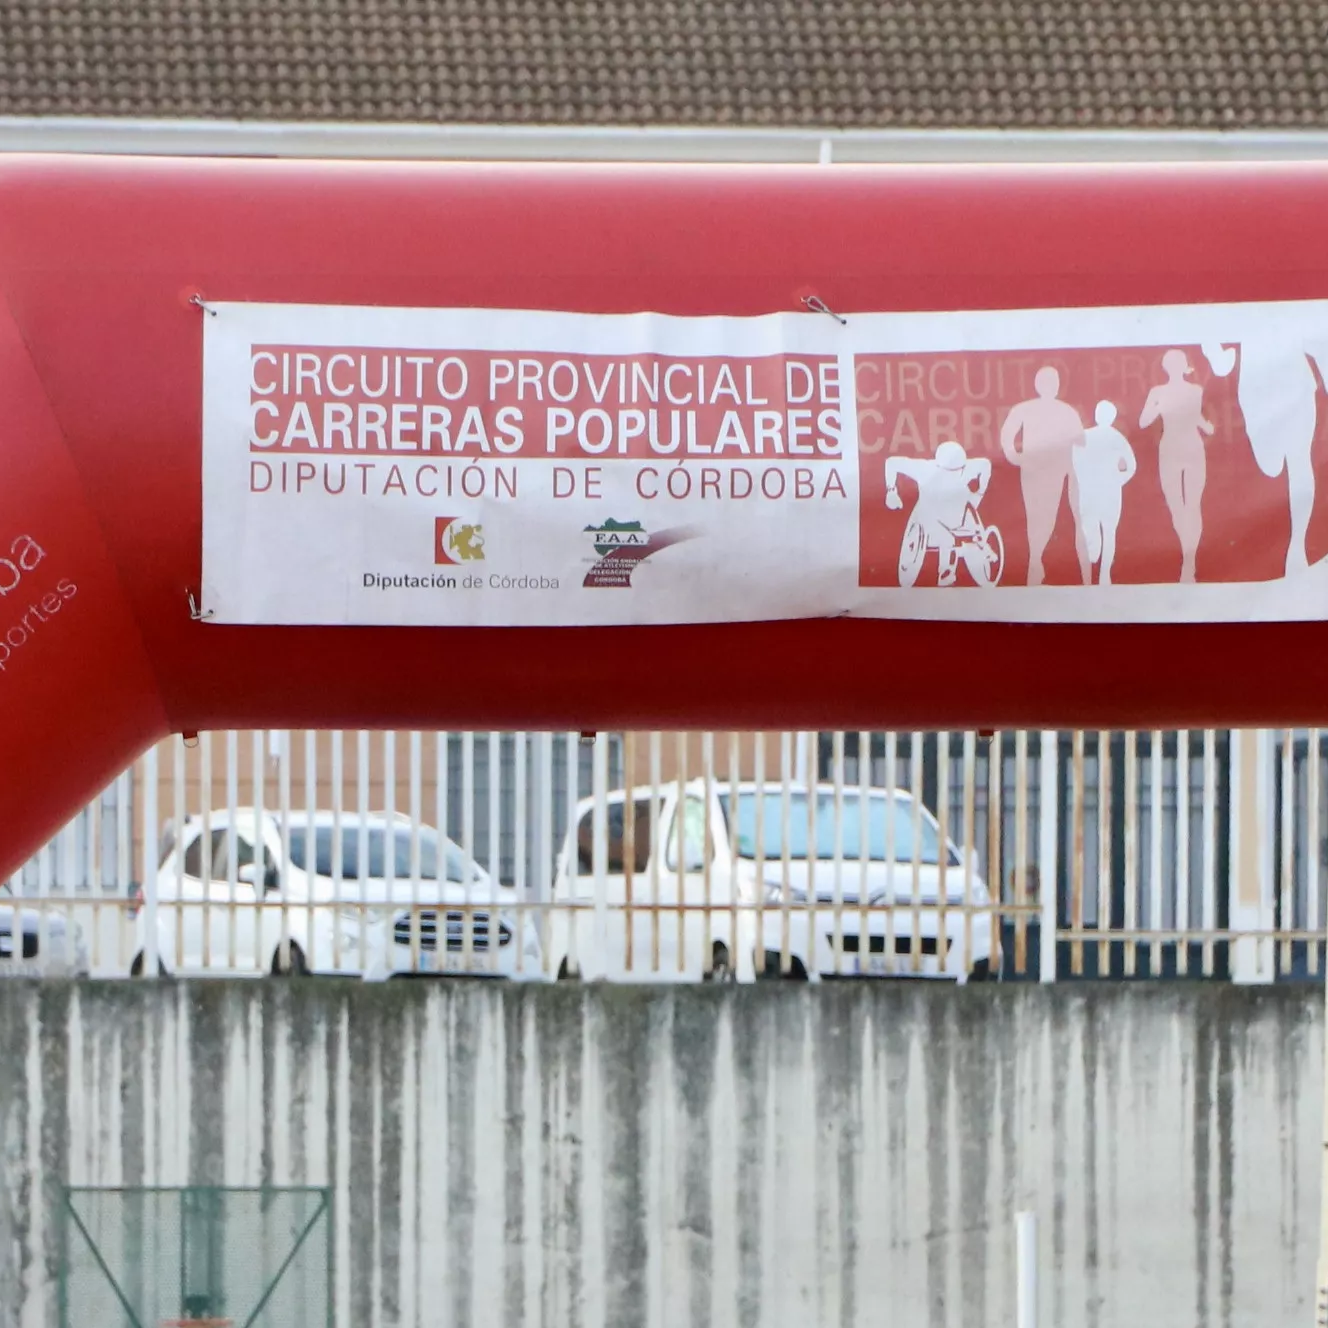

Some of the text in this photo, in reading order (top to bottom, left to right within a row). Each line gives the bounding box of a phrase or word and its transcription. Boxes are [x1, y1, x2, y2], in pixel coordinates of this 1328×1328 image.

[251, 352, 839, 405] CIRCUITO PROVINCIAL DE
[250, 400, 842, 455] CARRERAS POPULARES
[250, 456, 847, 500] DIPUTACIÓN DE CÓRDOBA
[595, 533, 644, 543] F.A.A.
[363, 573, 560, 590] Diputación de Córdoba
